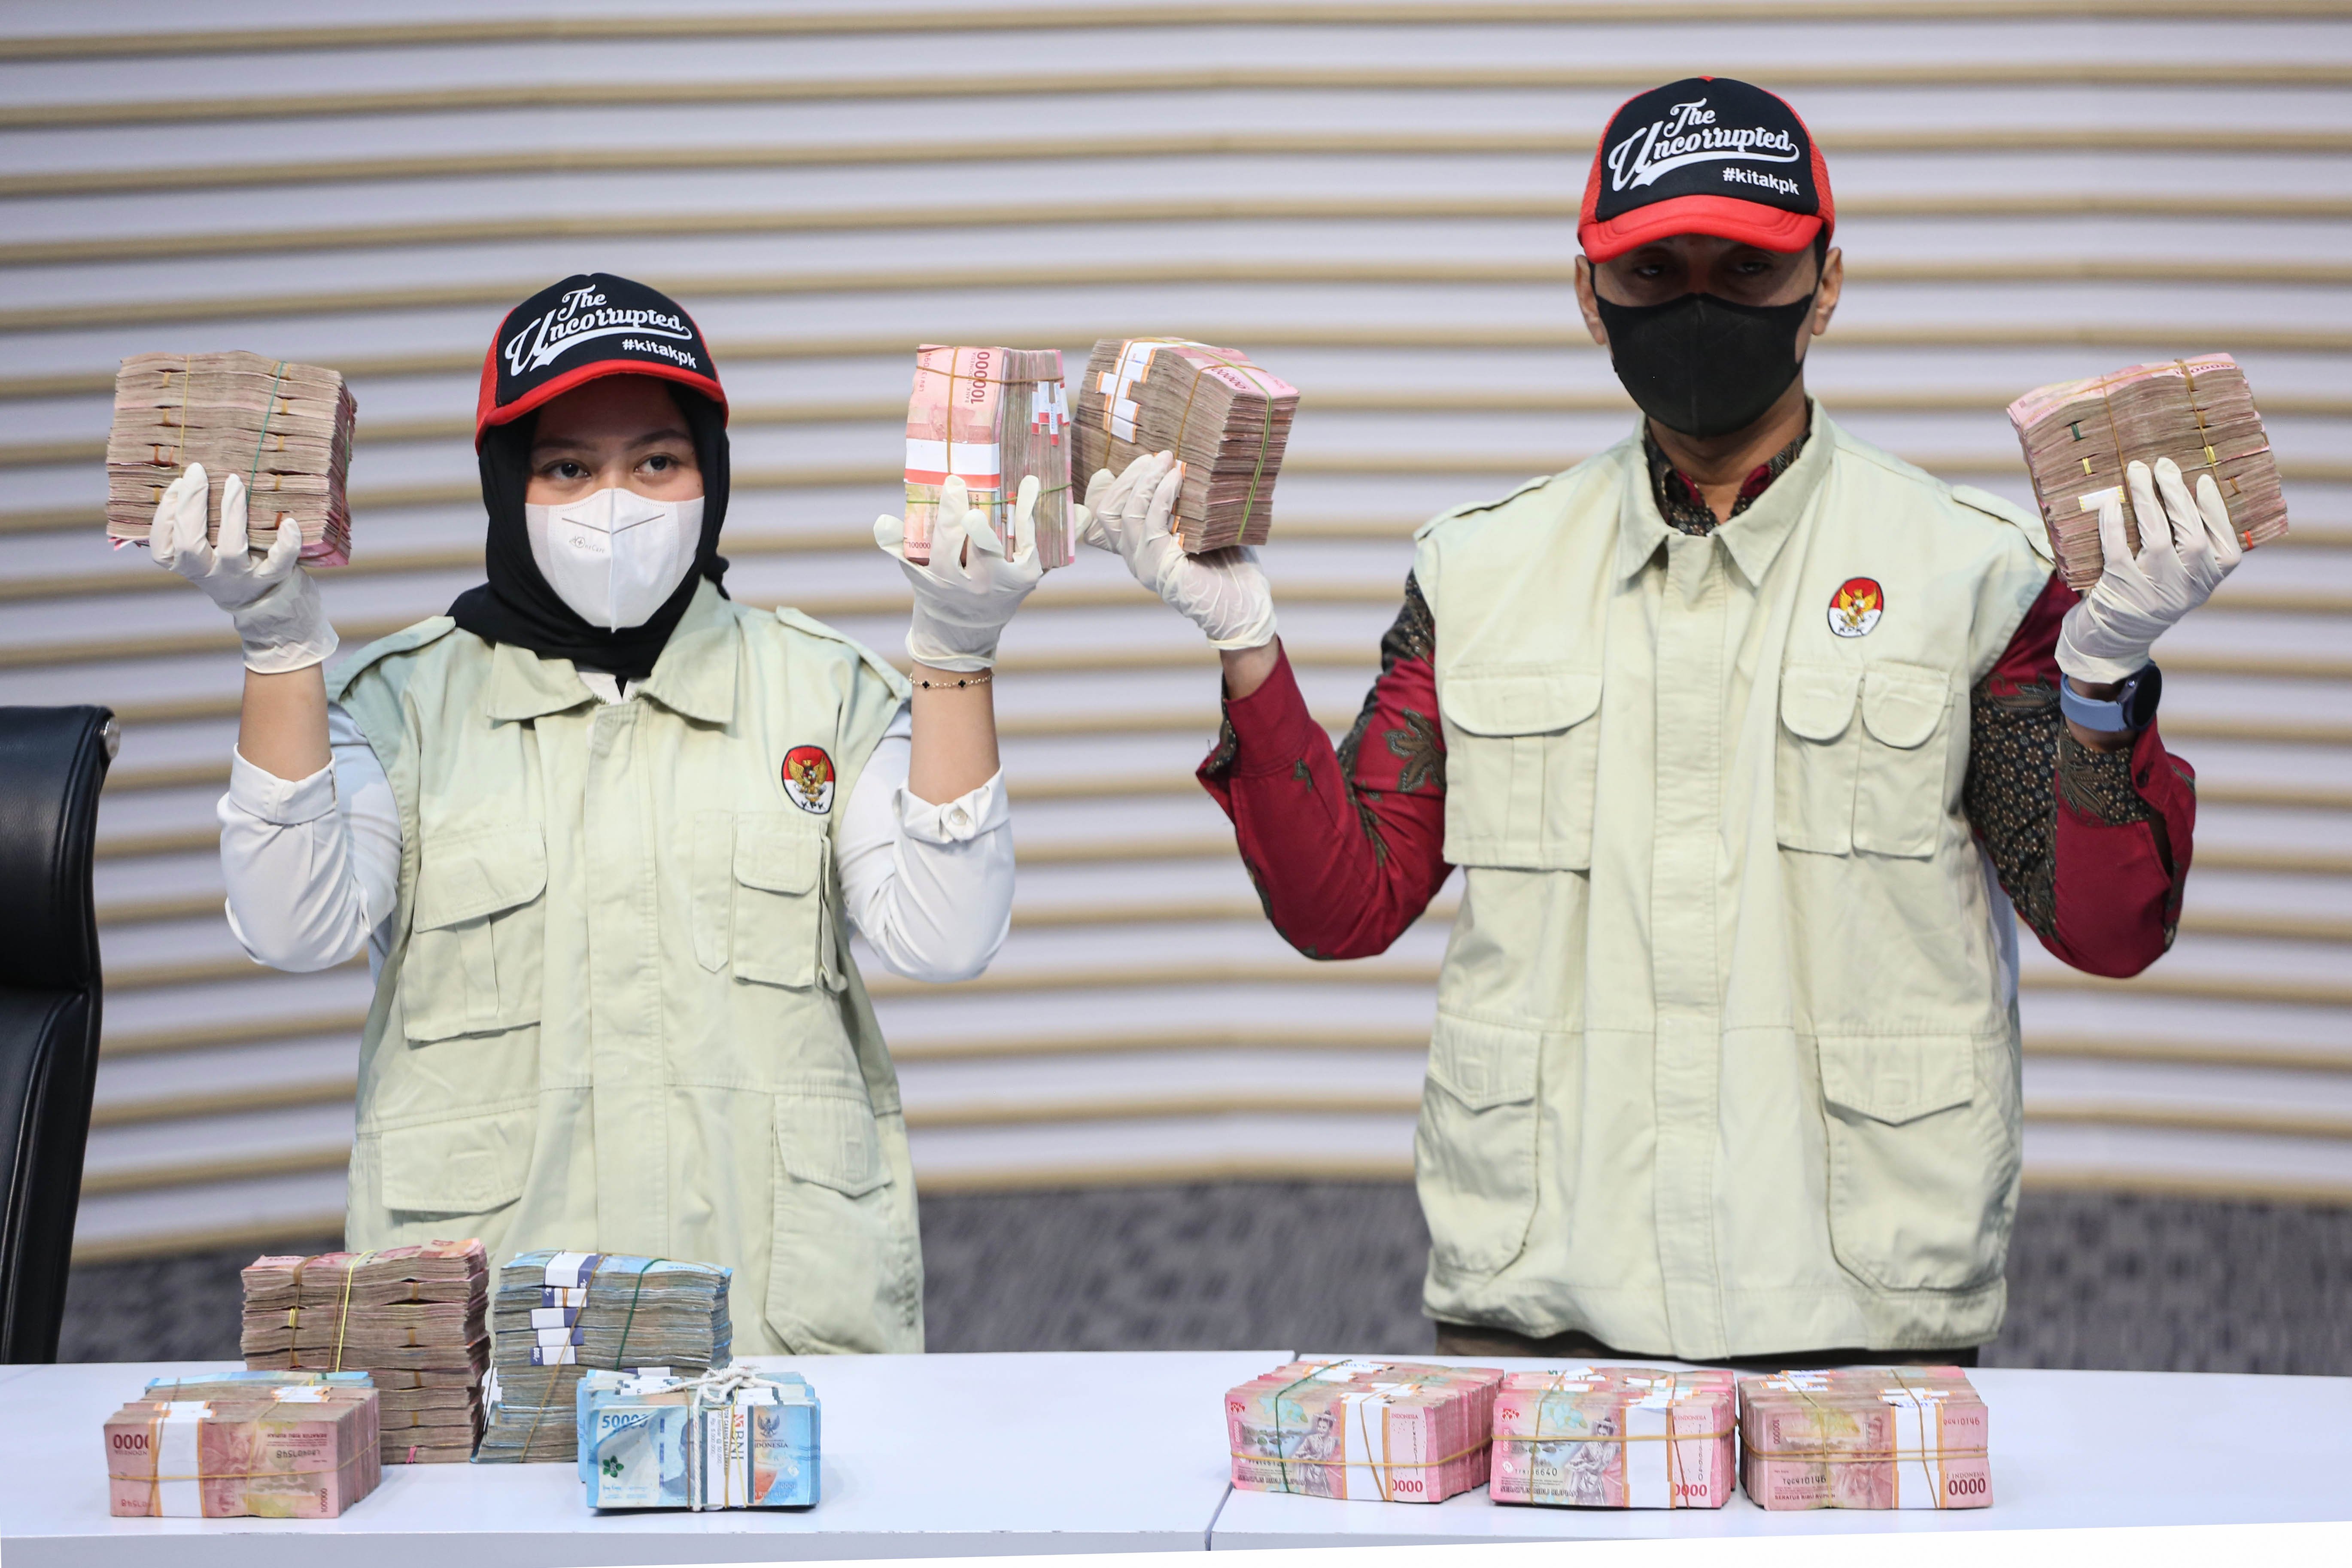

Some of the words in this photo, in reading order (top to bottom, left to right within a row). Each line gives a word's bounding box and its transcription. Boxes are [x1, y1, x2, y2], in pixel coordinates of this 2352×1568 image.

[1663, 97, 1716, 138] The
[1608, 120, 1799, 191] Uncorrupted
[1723, 167, 1800, 195] #kitakpk
[557, 284, 607, 322] The
[504, 308, 693, 377] Uncorrupted
[622, 338, 697, 369] #kitakpk
[970, 351, 991, 404] 100000
[907, 541, 931, 550] 100000
[731, 1431, 744, 1459] BNI
[1952, 1471, 1985, 1479] INDONESIA
